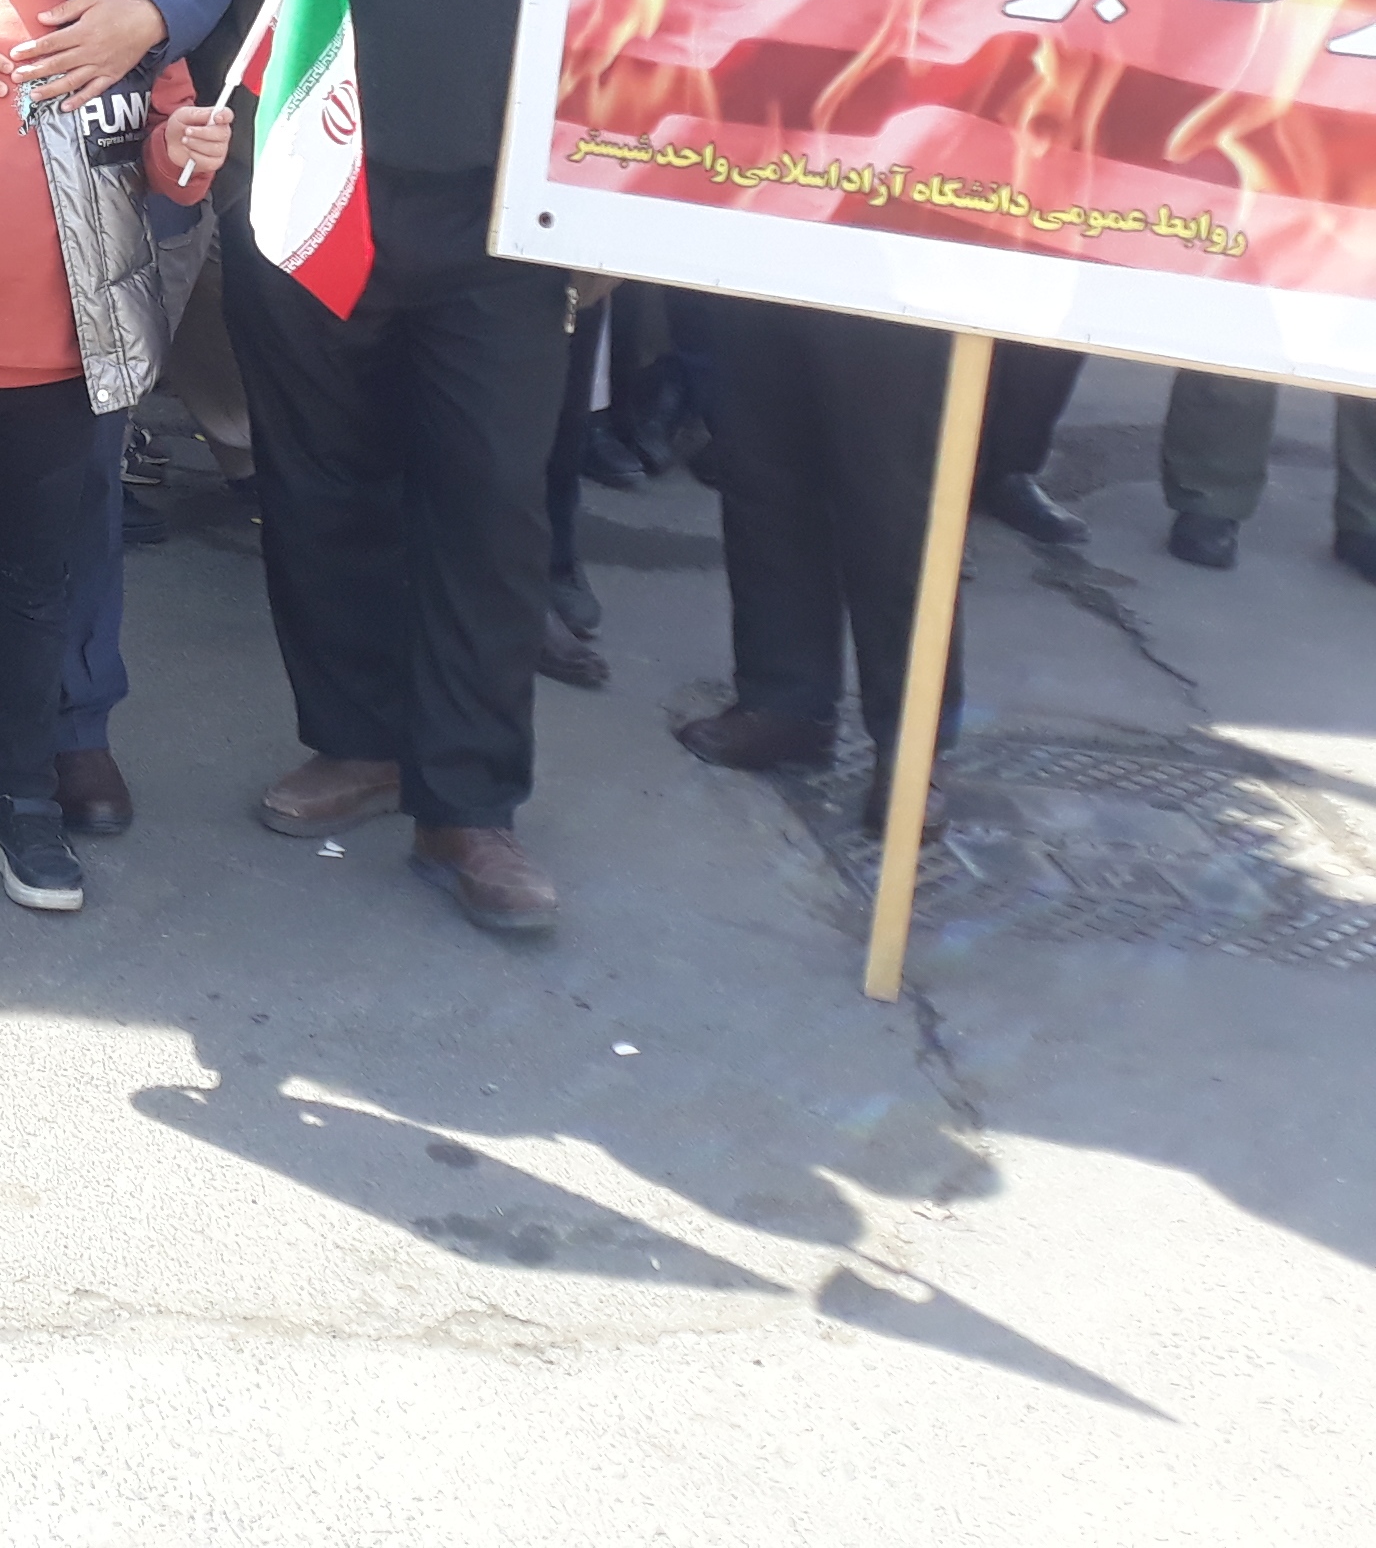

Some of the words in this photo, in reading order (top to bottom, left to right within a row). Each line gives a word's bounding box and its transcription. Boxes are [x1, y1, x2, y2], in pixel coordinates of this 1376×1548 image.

[569, 130, 654, 168] شبستر
[654, 141, 729, 184] واحد
[732, 153, 842, 194] اسلامی
[845, 163, 907, 209] آزاد
[912, 175, 1031, 219] دانشگاه
[1033, 197, 1150, 238] عمومی
[1152, 204, 1249, 256] روابط
